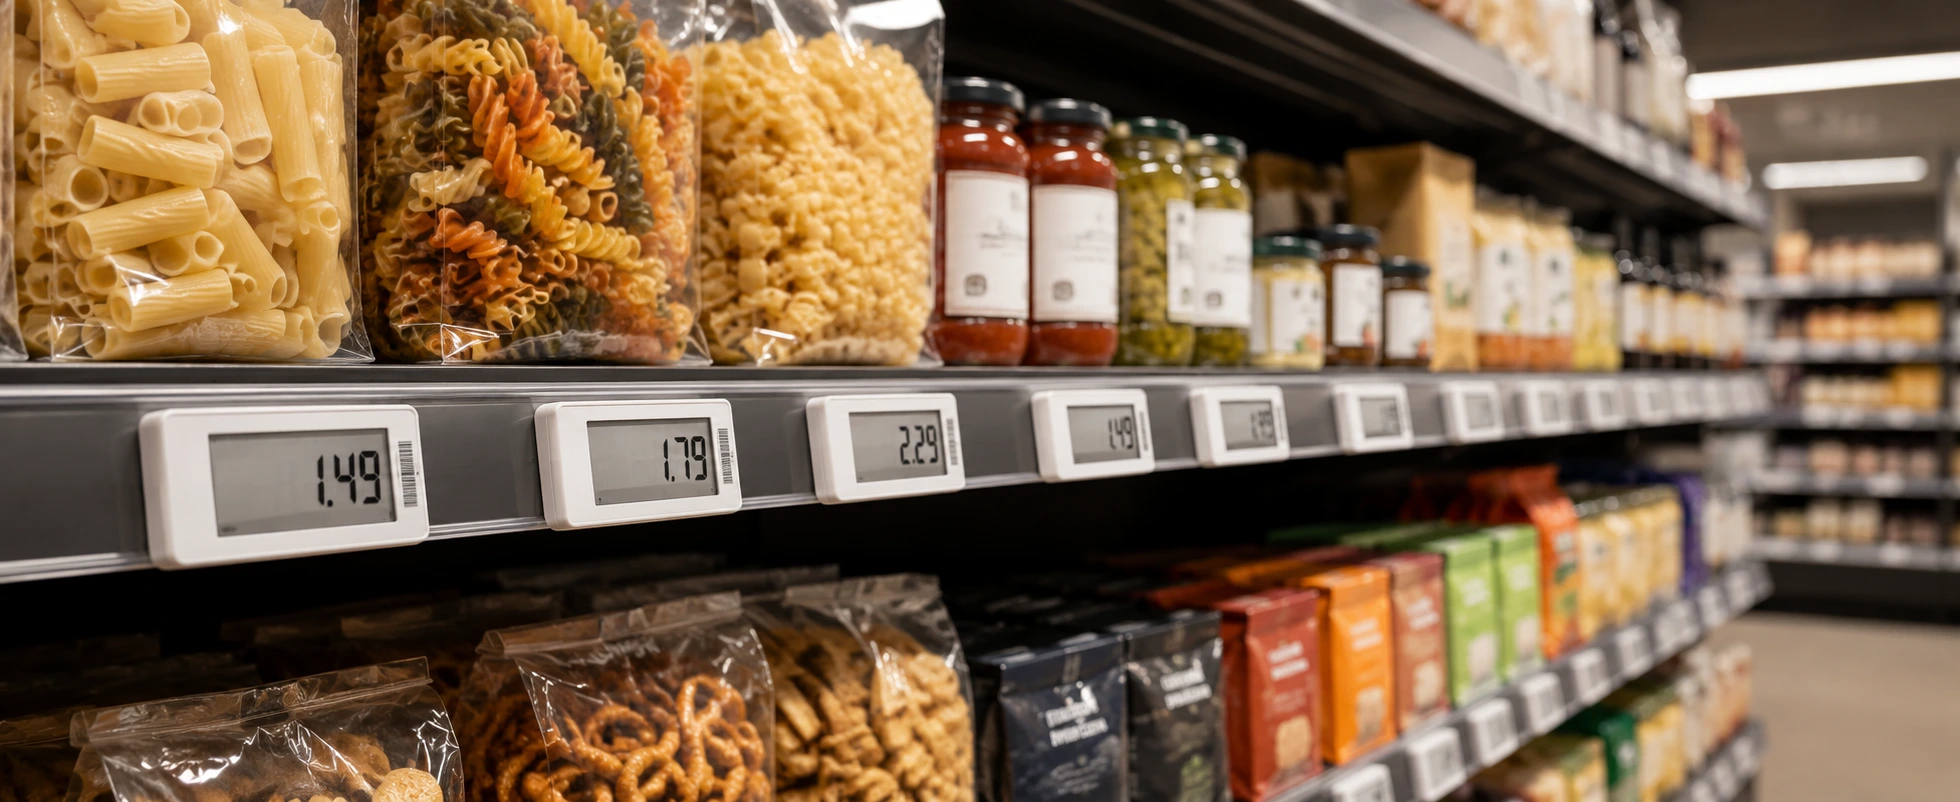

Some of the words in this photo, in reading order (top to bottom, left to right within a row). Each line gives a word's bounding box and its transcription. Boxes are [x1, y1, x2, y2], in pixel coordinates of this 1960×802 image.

[663, 435, 708, 482] 1.79
[899, 424, 939, 465] 2.29
[317, 450, 382, 507] 1.49
